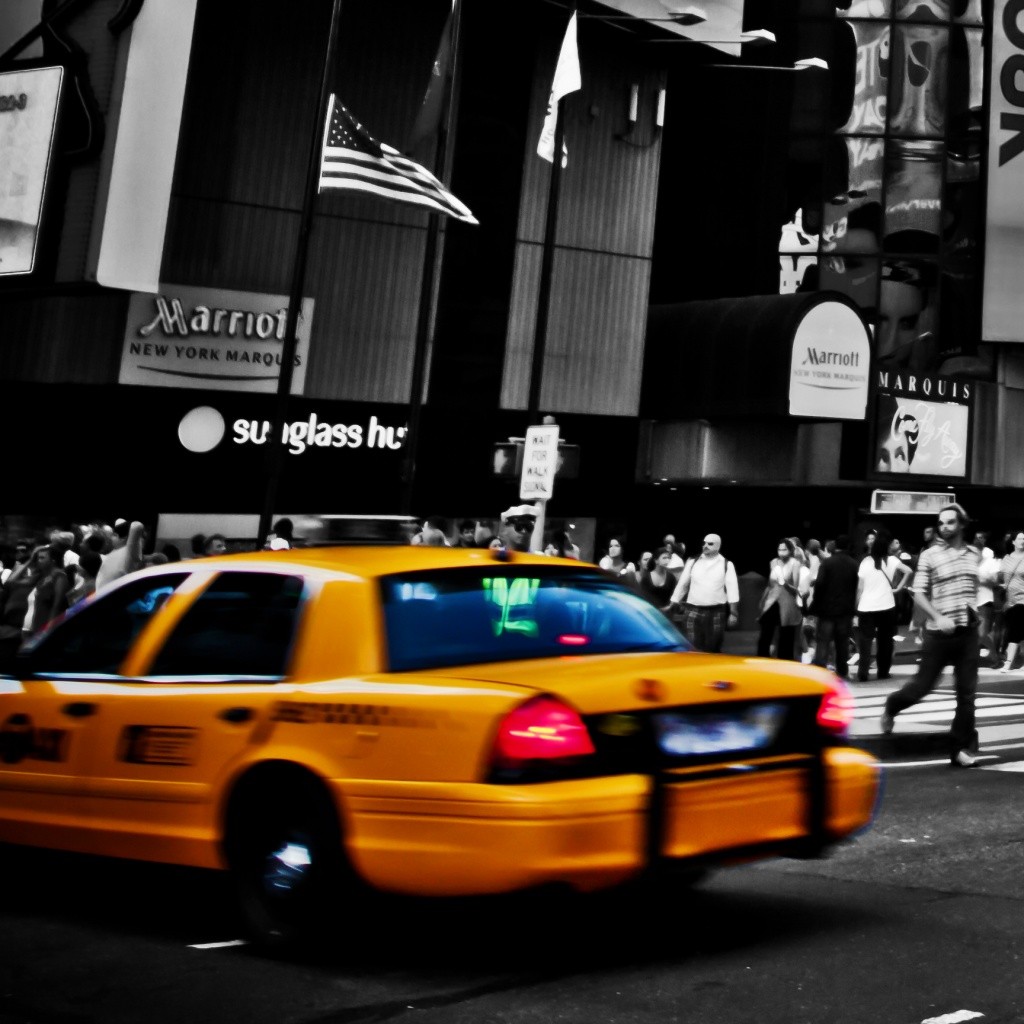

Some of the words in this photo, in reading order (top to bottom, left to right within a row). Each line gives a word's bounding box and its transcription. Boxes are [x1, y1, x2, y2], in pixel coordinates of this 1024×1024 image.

[129, 342, 169, 358] NEW
[175, 345, 220, 361] YORK
[802, 347, 859, 367] Marriott
[879, 371, 970, 399] MARQUIS
